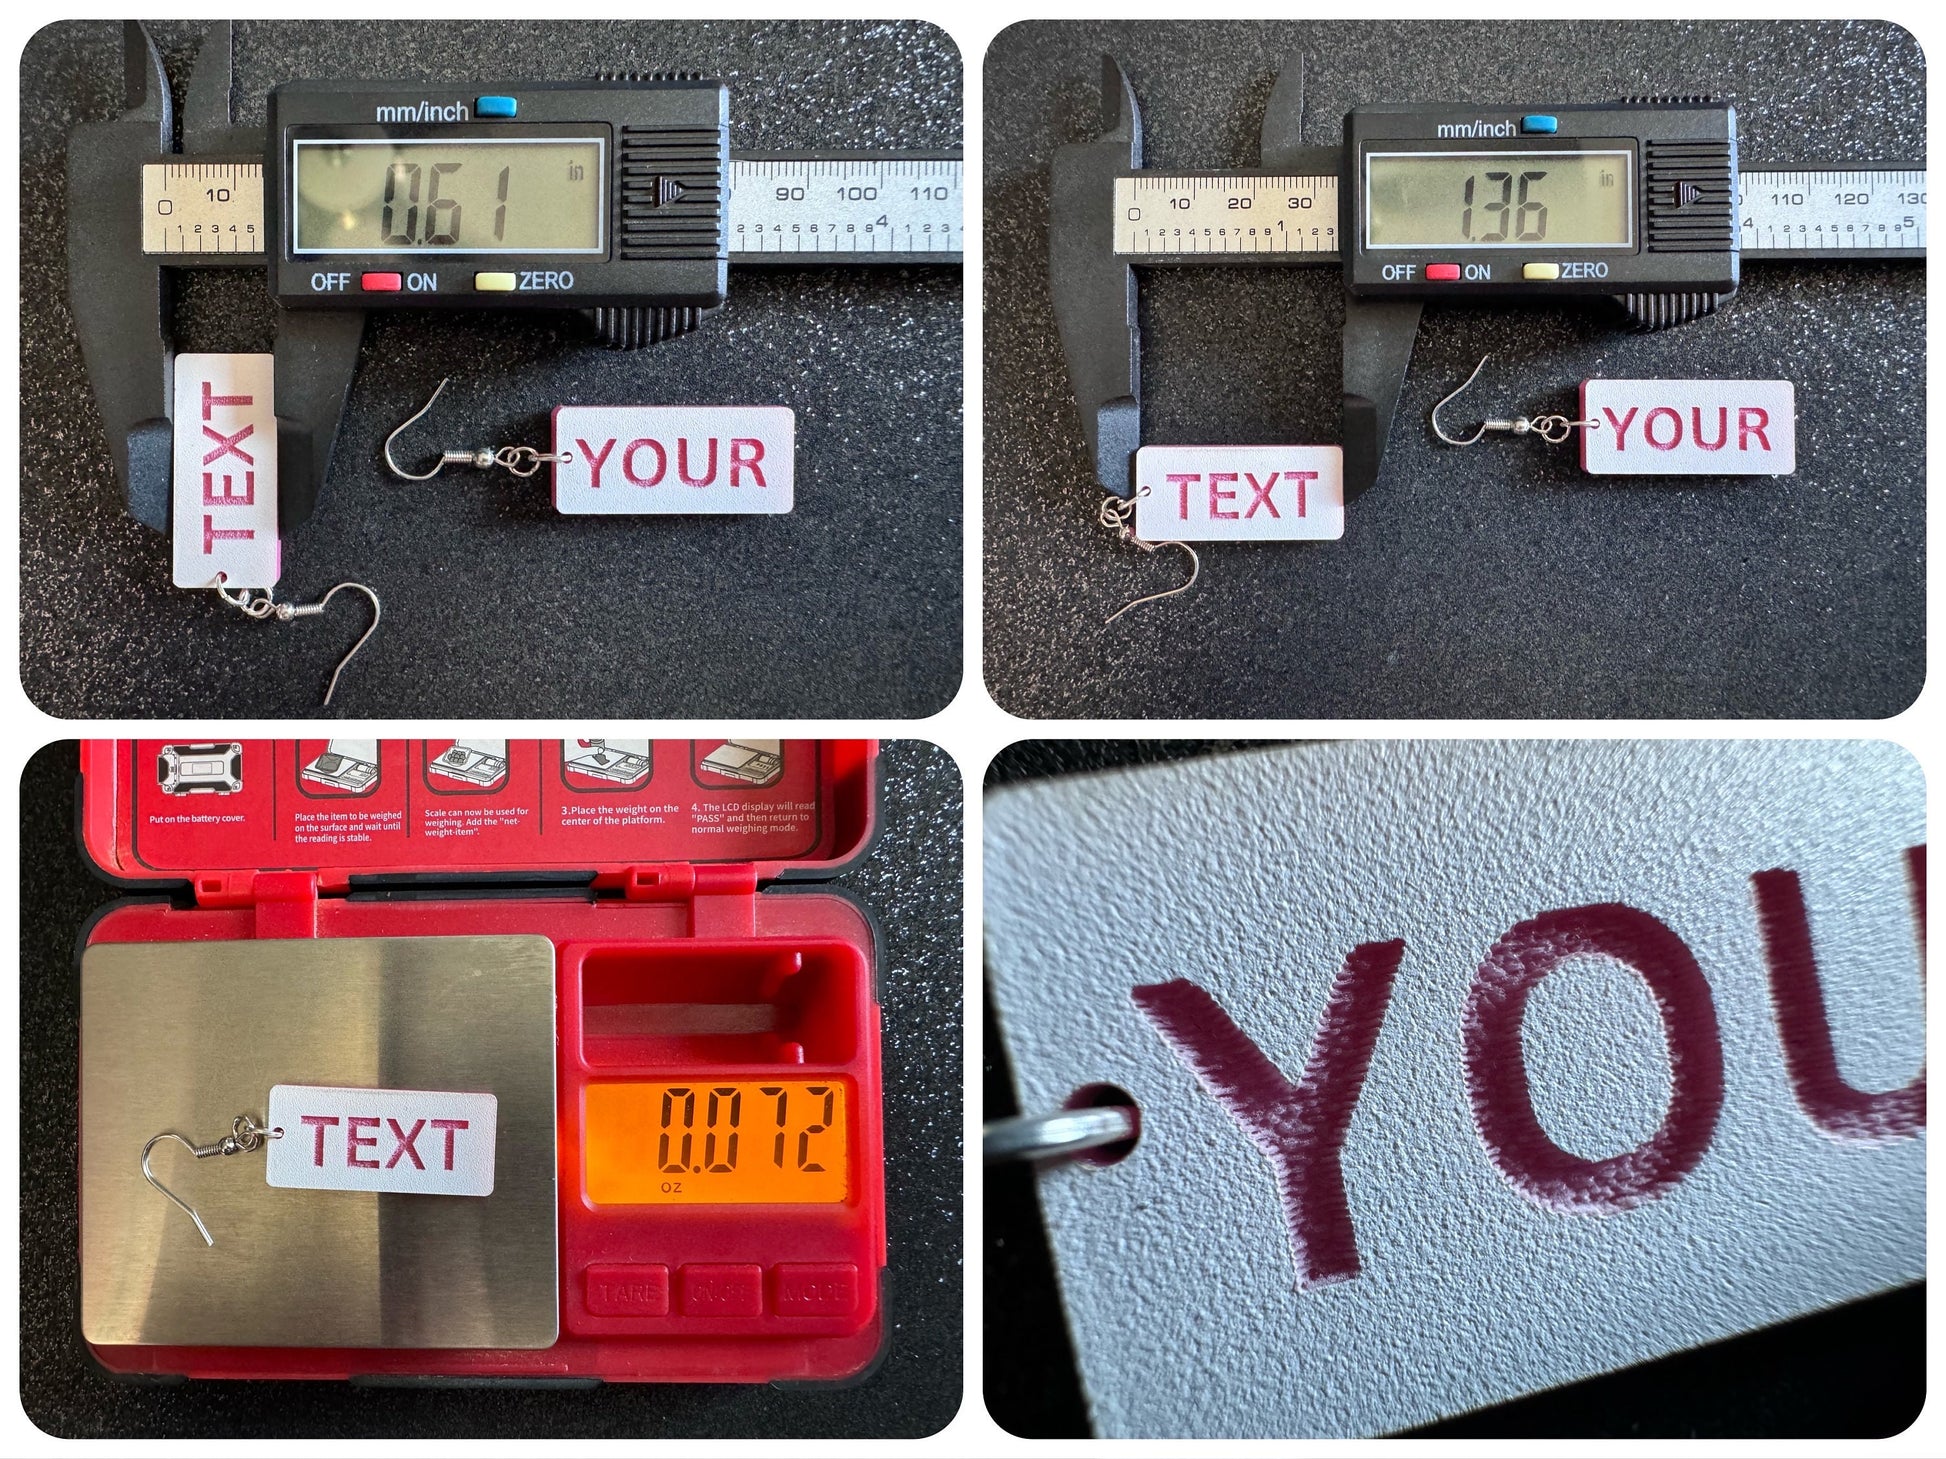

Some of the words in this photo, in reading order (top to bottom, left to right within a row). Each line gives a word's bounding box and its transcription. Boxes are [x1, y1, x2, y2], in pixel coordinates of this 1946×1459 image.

[376, 101, 469, 122] mm/inch
[1437, 120, 1517, 138] mm/inch
[206, 188, 230, 202] 10
[776, 187, 805, 201] 90
[837, 187, 877, 201] 100
[910, 187, 948, 201] 110
[1772, 194, 1804, 206] 110
[1834, 193, 1869, 205] 120
[381, 163, 509, 245] 0.61
[569, 160, 584, 181] in
[1170, 198, 1190, 210] 10
[1228, 198, 1252, 210] 20
[1288, 198, 1312, 208] 30
[1462, 171, 1547, 242] 1.36
[1600, 169, 1614, 187] in
[876, 214, 888, 228] 4
[1743, 217, 1754, 228] 4
[1904, 216, 1914, 228] 5
[1382, 265, 1416, 281] OFF
[1465, 264, 1491, 281] ON
[1562, 263, 1608, 278] ZERO
[311, 273, 351, 291] OFF
[407, 273, 437, 291] ON
[518, 271, 574, 290] ZERO
[1601, 407, 1772, 452] YOUR
[202, 381, 255, 554] TEXT
[575, 438, 767, 488] YOUR
[1166, 470, 1318, 520] TEXT
[561, 806, 596, 816] 3.Place
[598, 806, 613, 814] the
[616, 804, 648, 815] weight
[664, 804, 679, 812] the
[703, 803, 720, 812] The
[722, 803, 740, 812] LCD
[742, 802, 774, 812] display
[776, 802, 793, 810] will
[795, 802, 816, 810] read
[149, 816, 164, 824] Put
[192, 814, 220, 824] battery
[295, 813, 315, 822] Place
[316, 812, 329, 820] the
[330, 812, 348, 820] item
[359, 812, 368, 820] be
[370, 810, 402, 821] weighed
[425, 818, 464, 828] weighing.
[466, 818, 482, 826] Add
[484, 818, 498, 826] the
[562, 818, 591, 826] center
[592, 816, 602, 825] of
[604, 816, 620, 825] the
[622, 815, 666, 826] platform.
[692, 814, 724, 822] "PASS"
[727, 814, 744, 822] and
[746, 813, 767, 822] then
[770, 813, 798, 821] return
[320, 823, 348, 831] surface
[364, 822, 381, 830] wait
[383, 822, 400, 830] until
[692, 825, 724, 834] normal
[726, 824, 768, 834] weighing
[770, 823, 798, 832] mode.
[309, 834, 338, 844] reading
[347, 834, 372, 842] stable.
[658, 1086, 834, 1174] 0.072
[300, 1115, 469, 1171] TEXT
